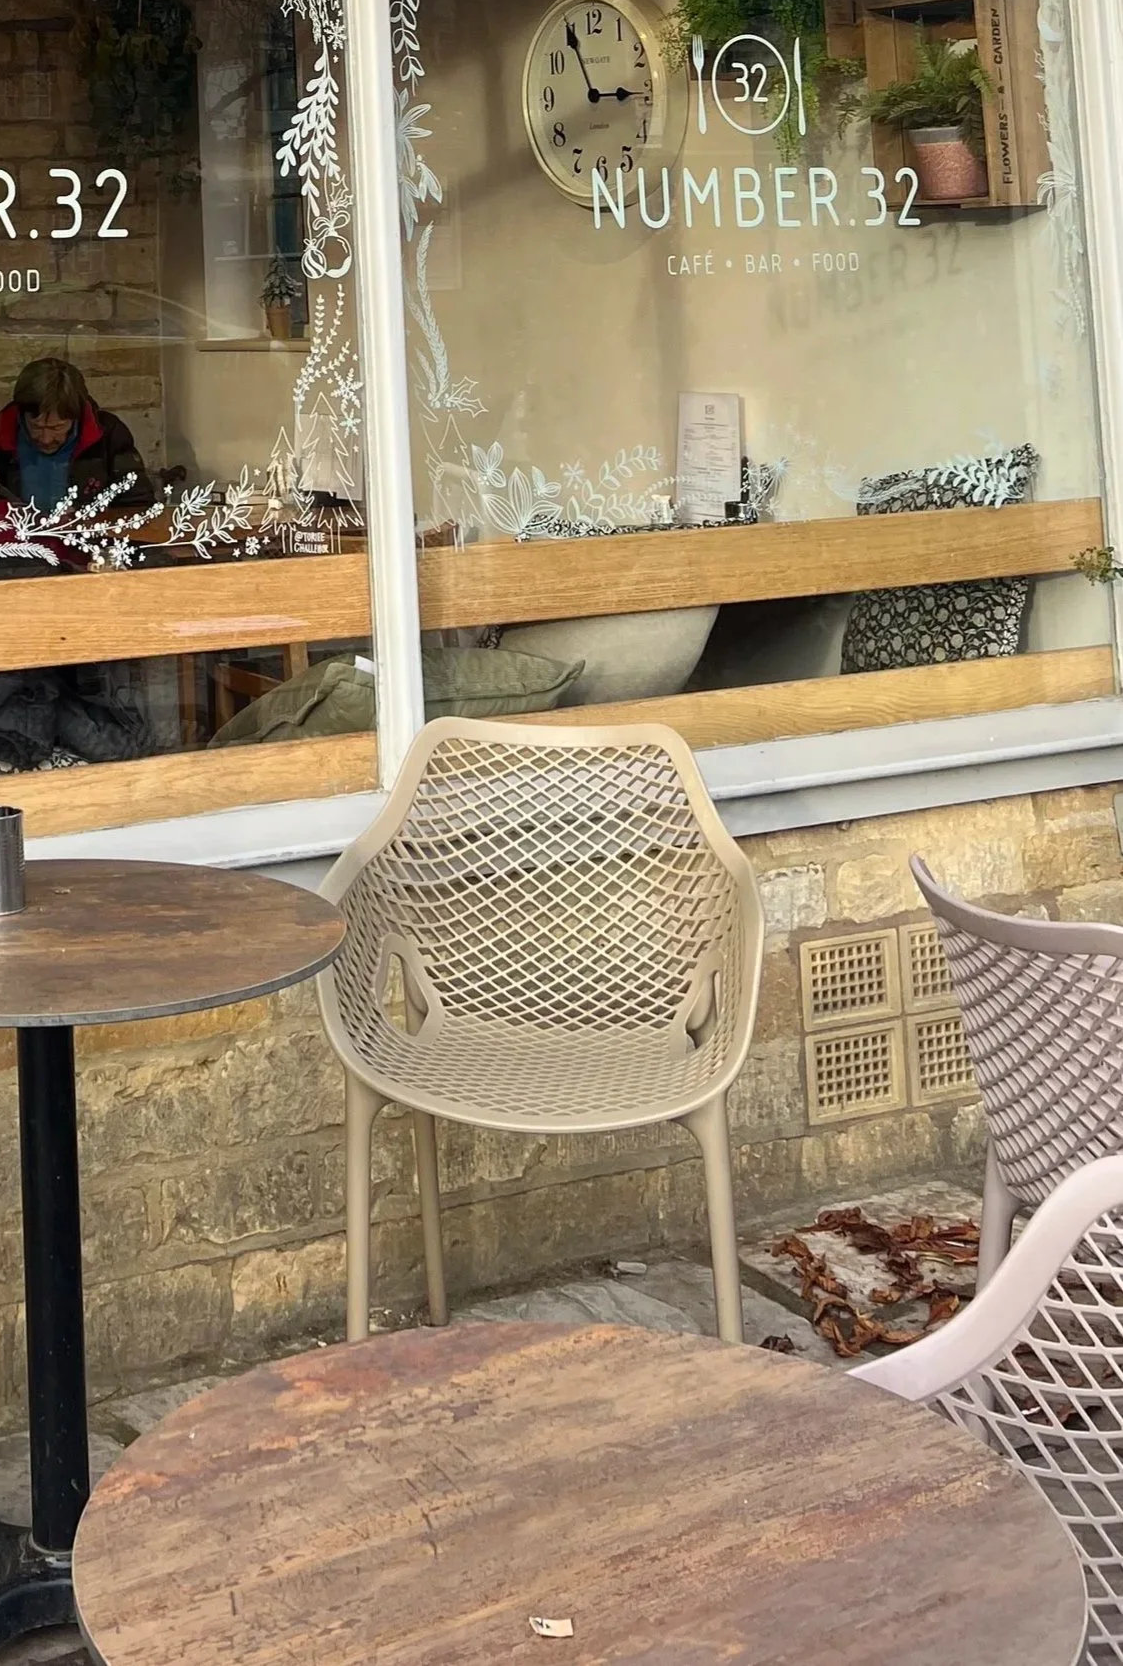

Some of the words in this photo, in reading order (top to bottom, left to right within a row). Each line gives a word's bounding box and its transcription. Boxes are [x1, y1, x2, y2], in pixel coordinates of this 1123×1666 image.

[585, 8, 603, 35] 12
[615, 17, 623, 42] 1
[990, 7, 1003, 65] GARDEN
[549, 49, 565, 75] 10
[633, 42, 645, 68] 2
[731, 62, 769, 103] 32
[543, 86, 555, 112] 9
[553, 121, 566, 147] 8
[636, 118, 648, 144] 4
[572, 148, 583, 174] 7
[620, 145, 633, 173] 5
[998, 111, 1013, 185] FLOWERS
[591, 166, 921, 229] NUMBER.32
[667, 248, 715, 275] CAFÉ
[744, 253, 783, 274] BAR
[812, 252, 860, 272] FOOD
